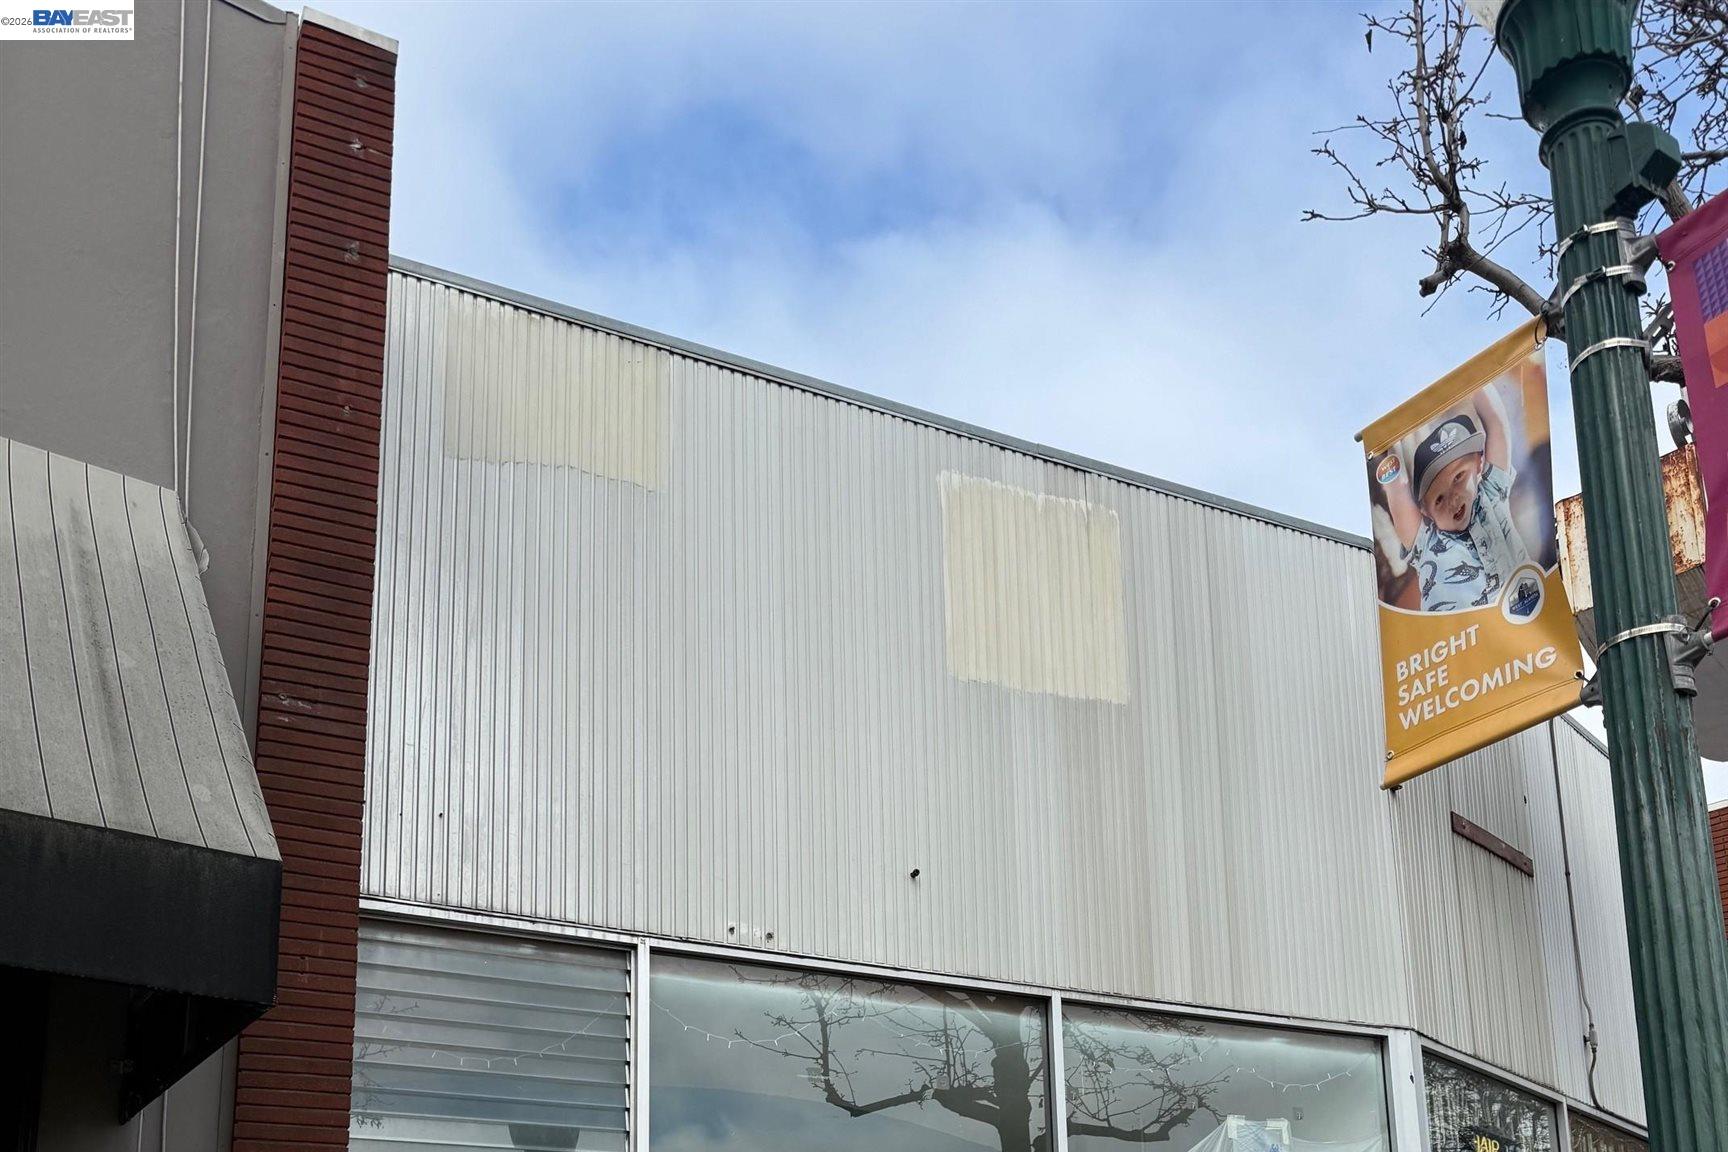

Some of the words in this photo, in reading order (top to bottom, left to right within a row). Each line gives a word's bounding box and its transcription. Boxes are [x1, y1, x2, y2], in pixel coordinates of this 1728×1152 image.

[1396, 624, 1480, 683] BRIGHT
[1398, 665, 1449, 706] SAFE
[1398, 646, 1558, 731] WELCOMING
